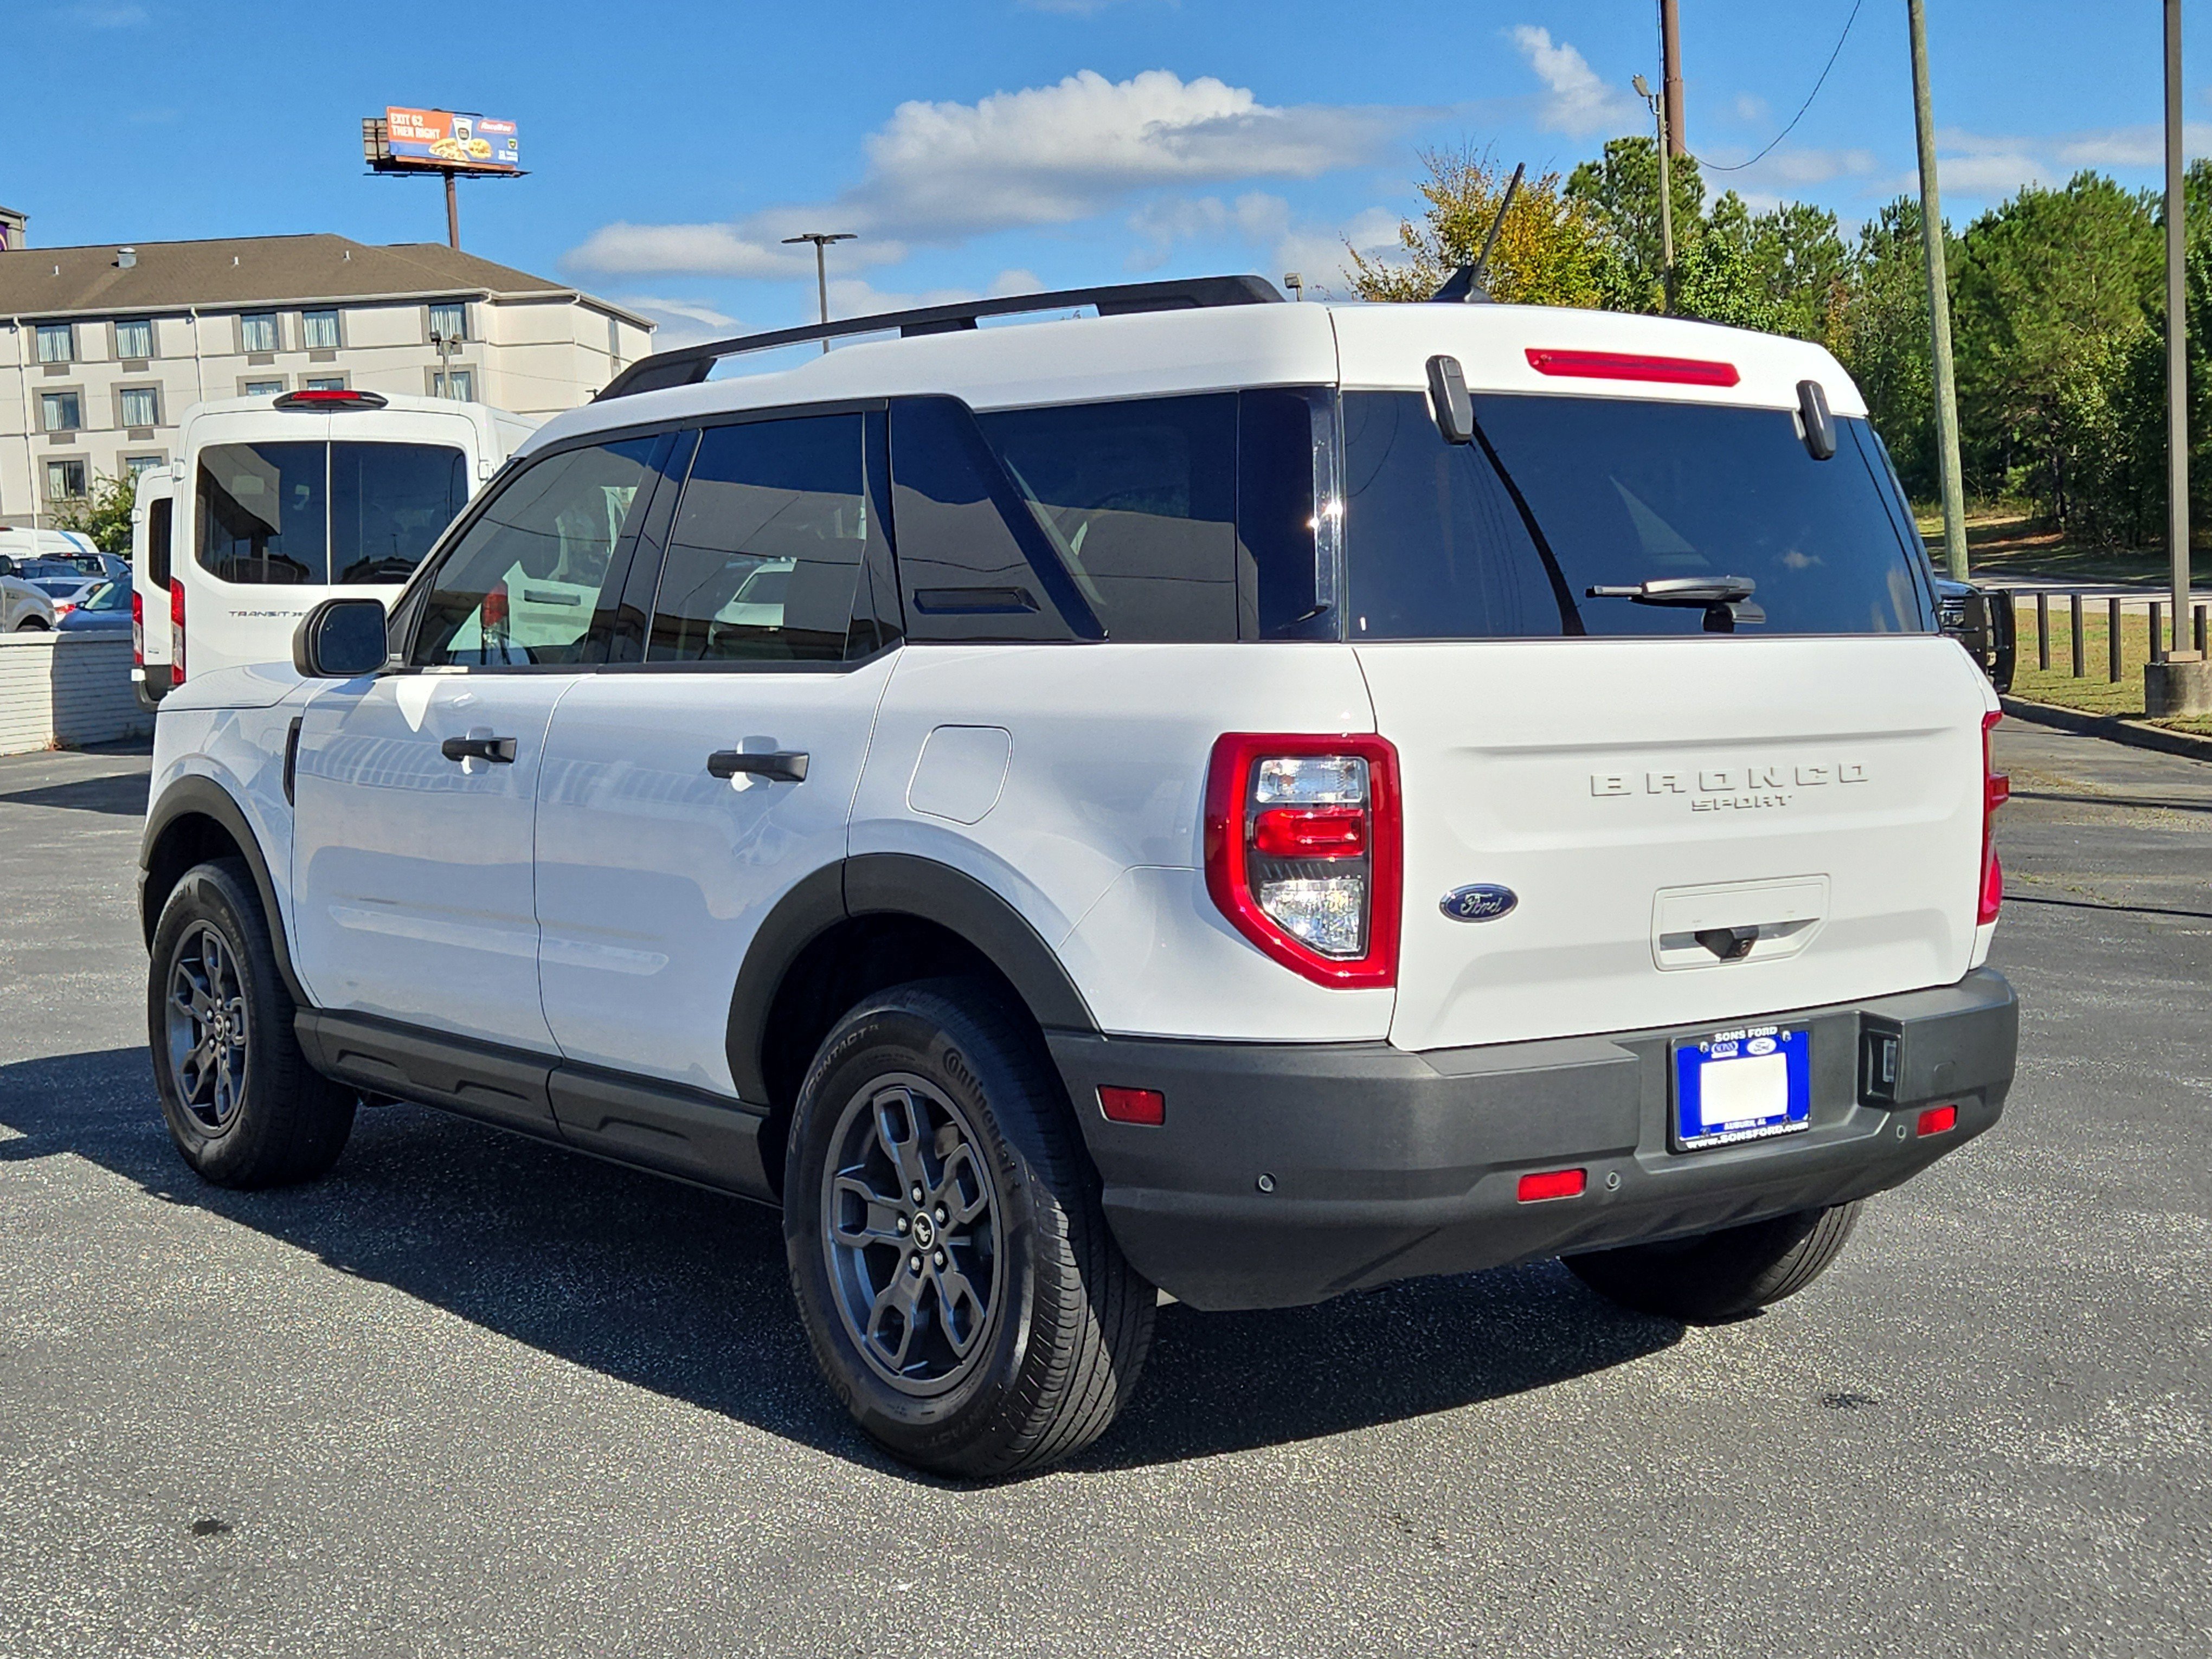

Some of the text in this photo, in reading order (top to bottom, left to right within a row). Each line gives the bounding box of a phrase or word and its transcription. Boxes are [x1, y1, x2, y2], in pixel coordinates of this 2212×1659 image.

[390, 112, 424, 126] EXIT 62
[391, 125, 440, 140] THEN RIGHT
[1590, 762, 1869, 797] BRONCO
[1691, 793, 1792, 812] SPORT
[1459, 892, 1503, 916] Ford
[1714, 1026, 1778, 1043] SONS FORD
